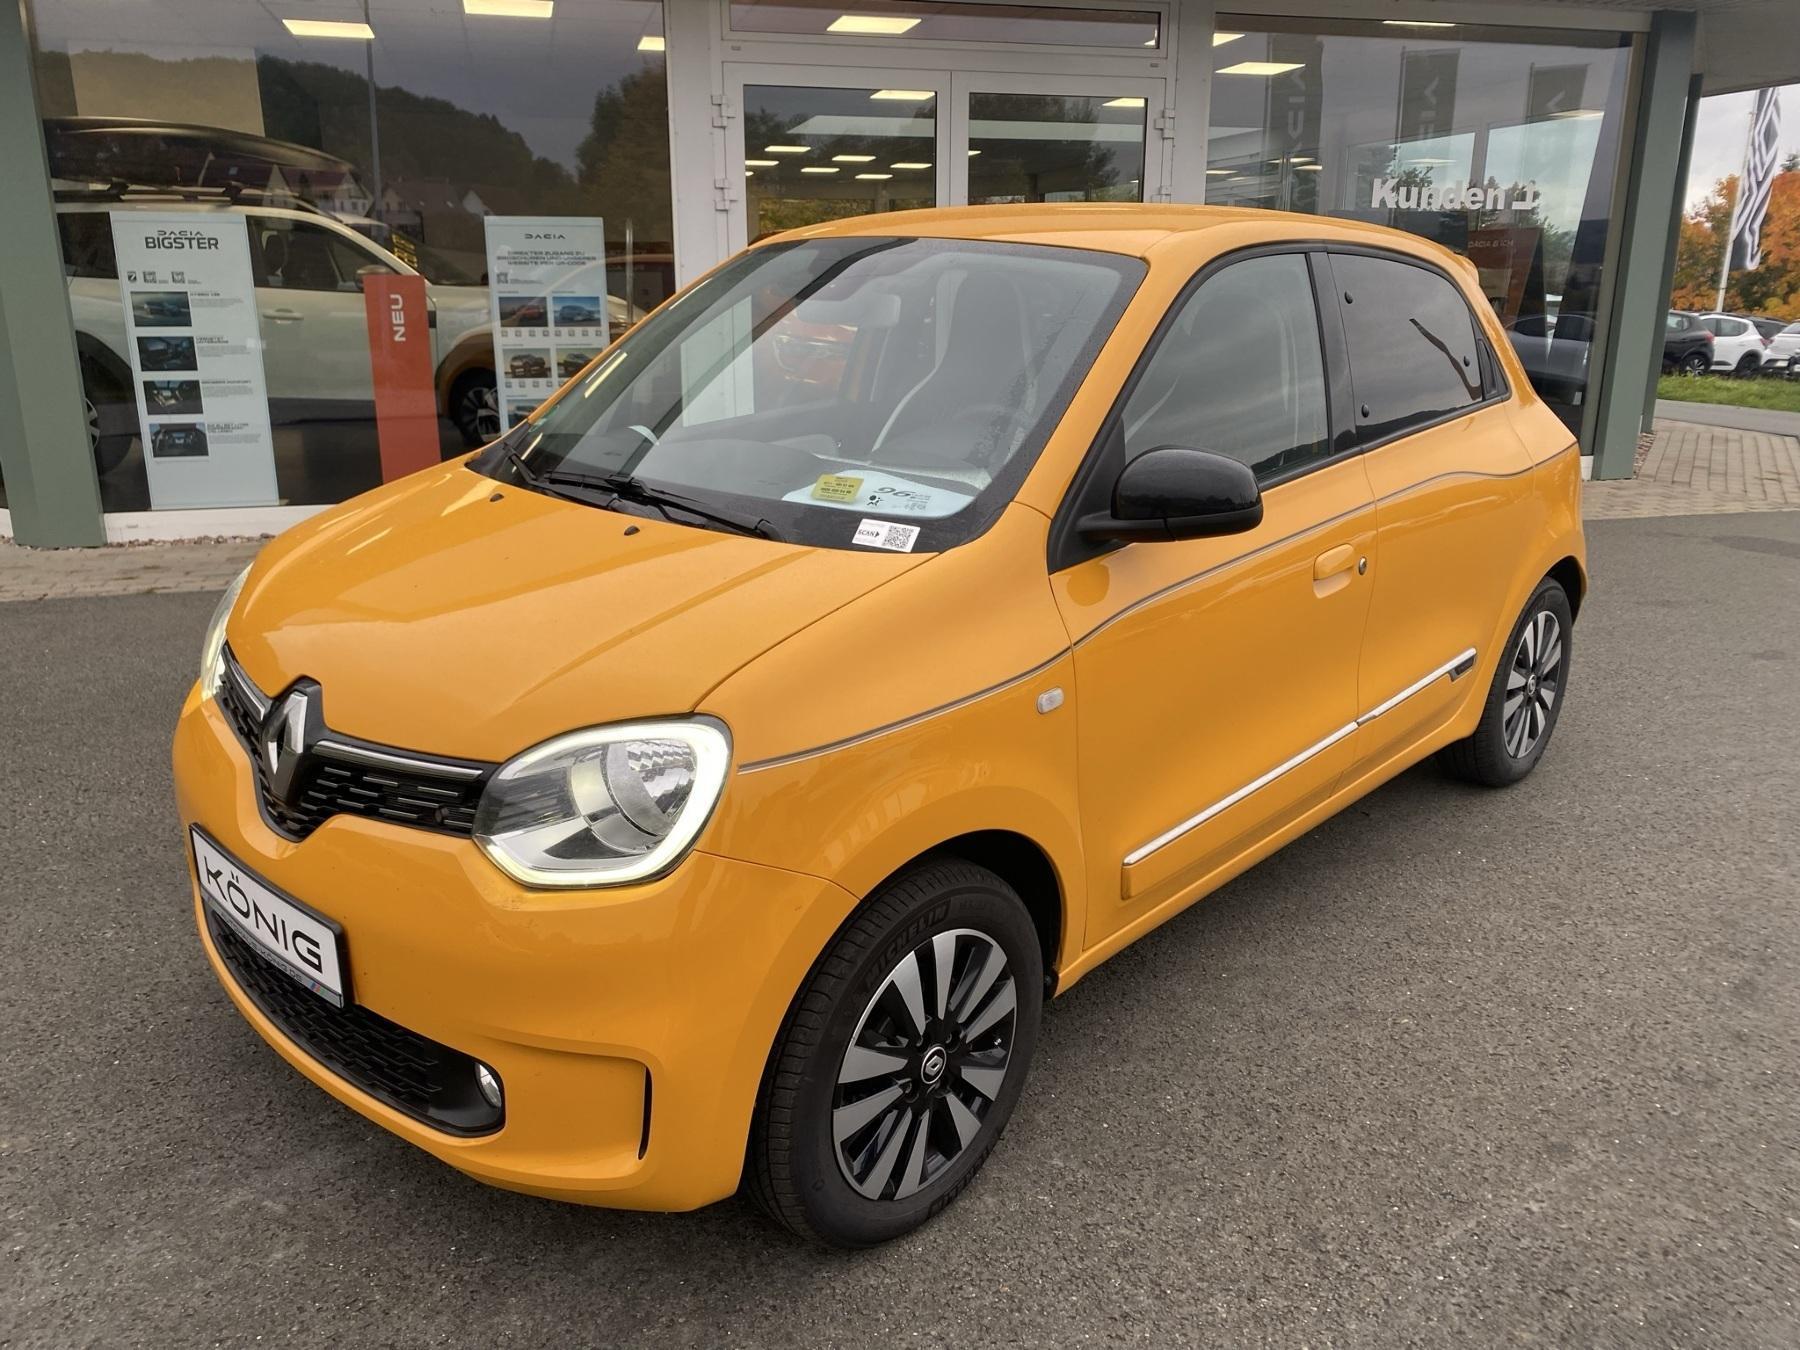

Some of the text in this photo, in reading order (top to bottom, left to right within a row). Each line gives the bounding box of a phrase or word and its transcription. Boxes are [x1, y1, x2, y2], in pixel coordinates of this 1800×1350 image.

[1371, 177, 1504, 210] Kunden
[145, 236, 220, 250] BIGSTER
[390, 294, 406, 342] NEU
[858, 529, 876, 537] SCAN
[204, 856, 323, 975] KÖNIG
